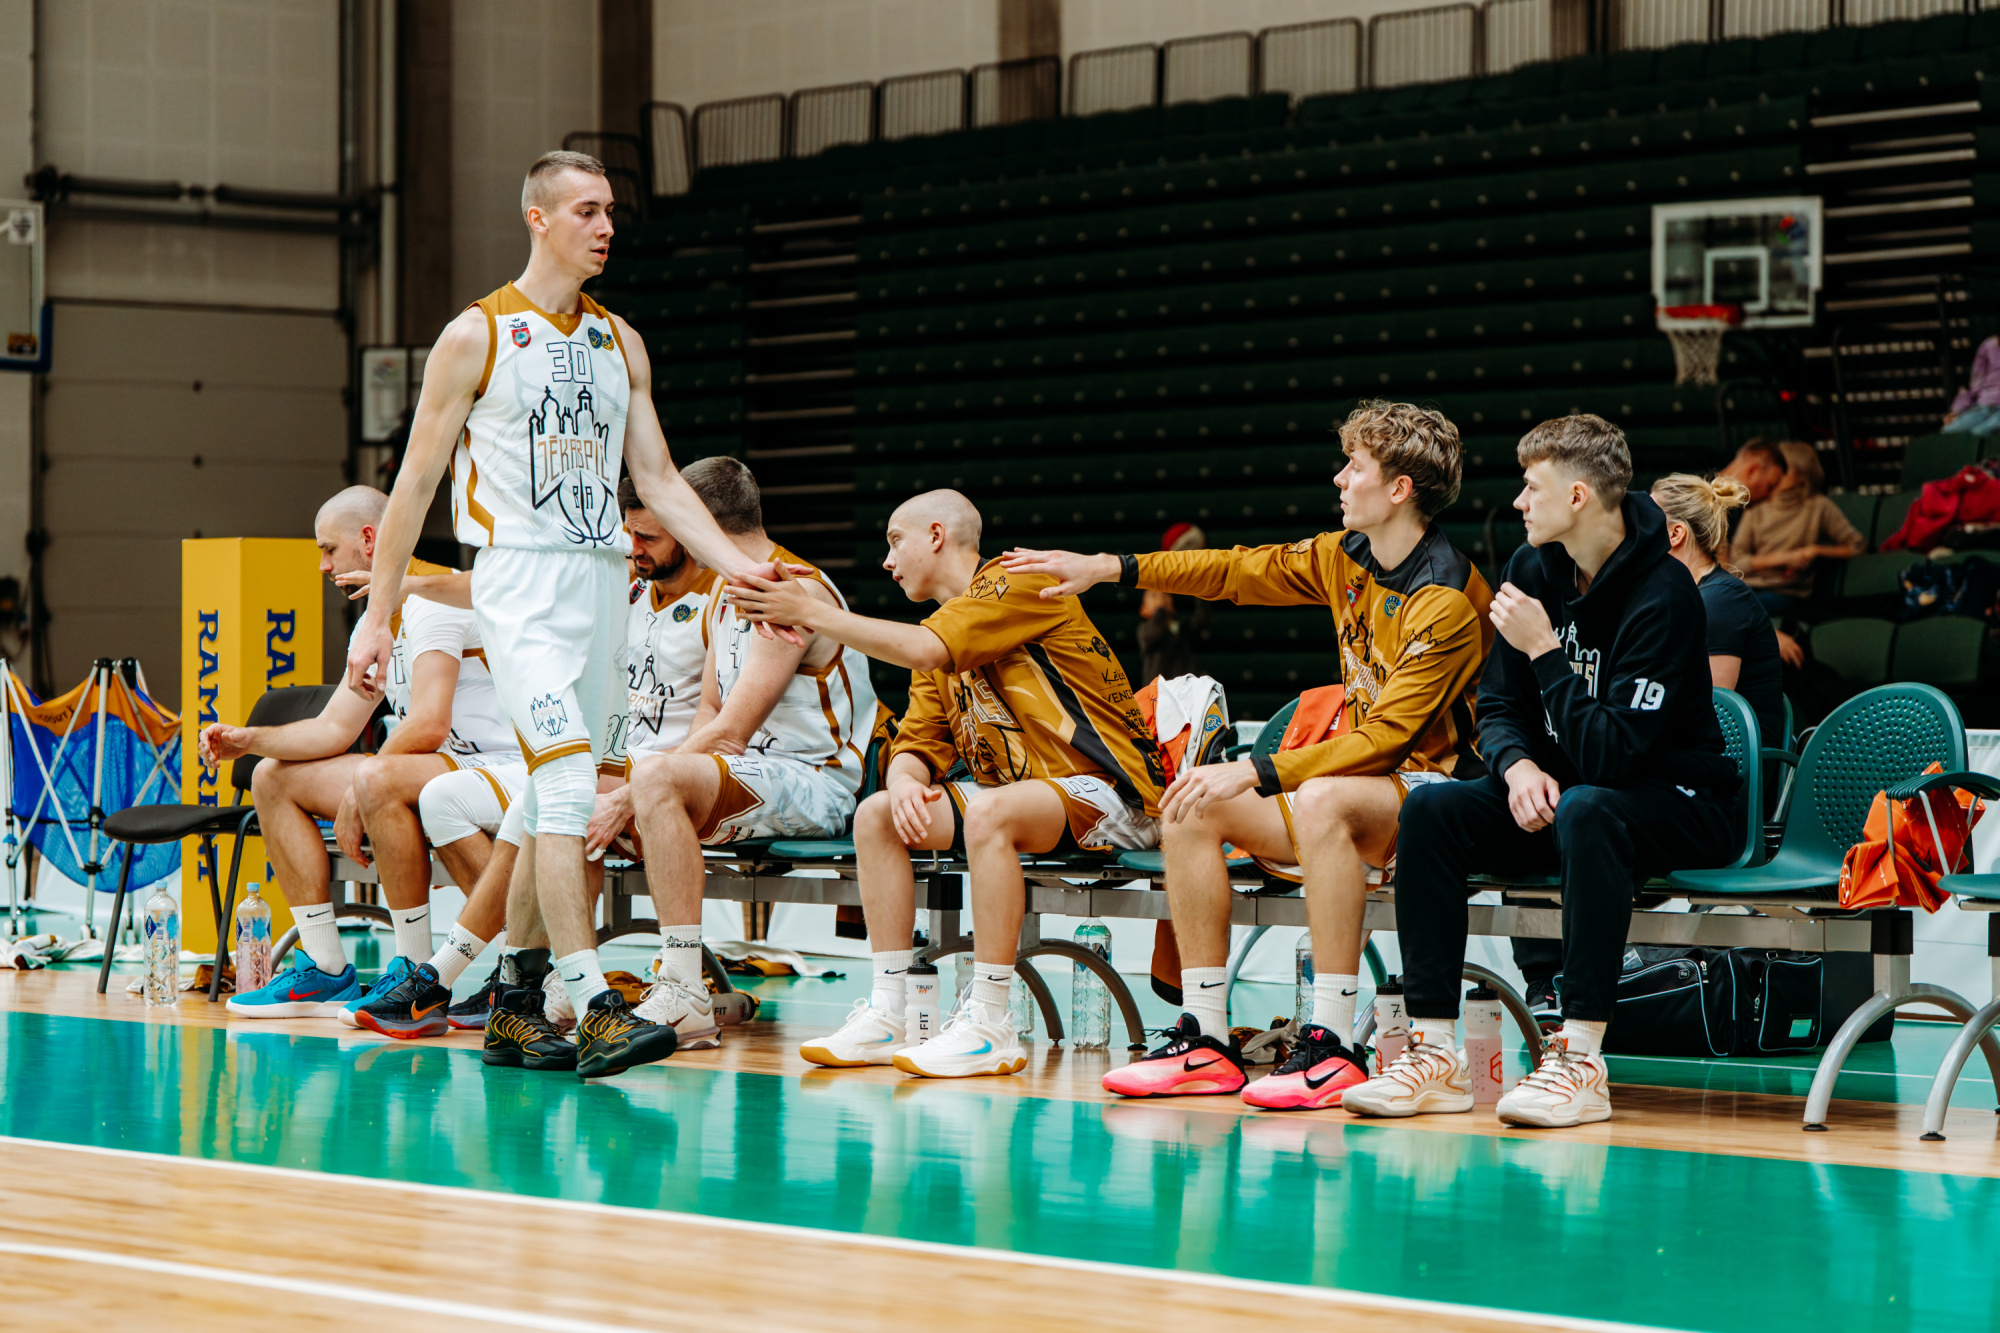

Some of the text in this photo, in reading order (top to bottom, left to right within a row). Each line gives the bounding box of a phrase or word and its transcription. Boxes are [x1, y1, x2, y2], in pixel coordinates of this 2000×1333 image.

[546, 341, 593, 384] 30
[1629, 678, 1665, 710] 19
[714, 1007, 727, 1016] FIT
